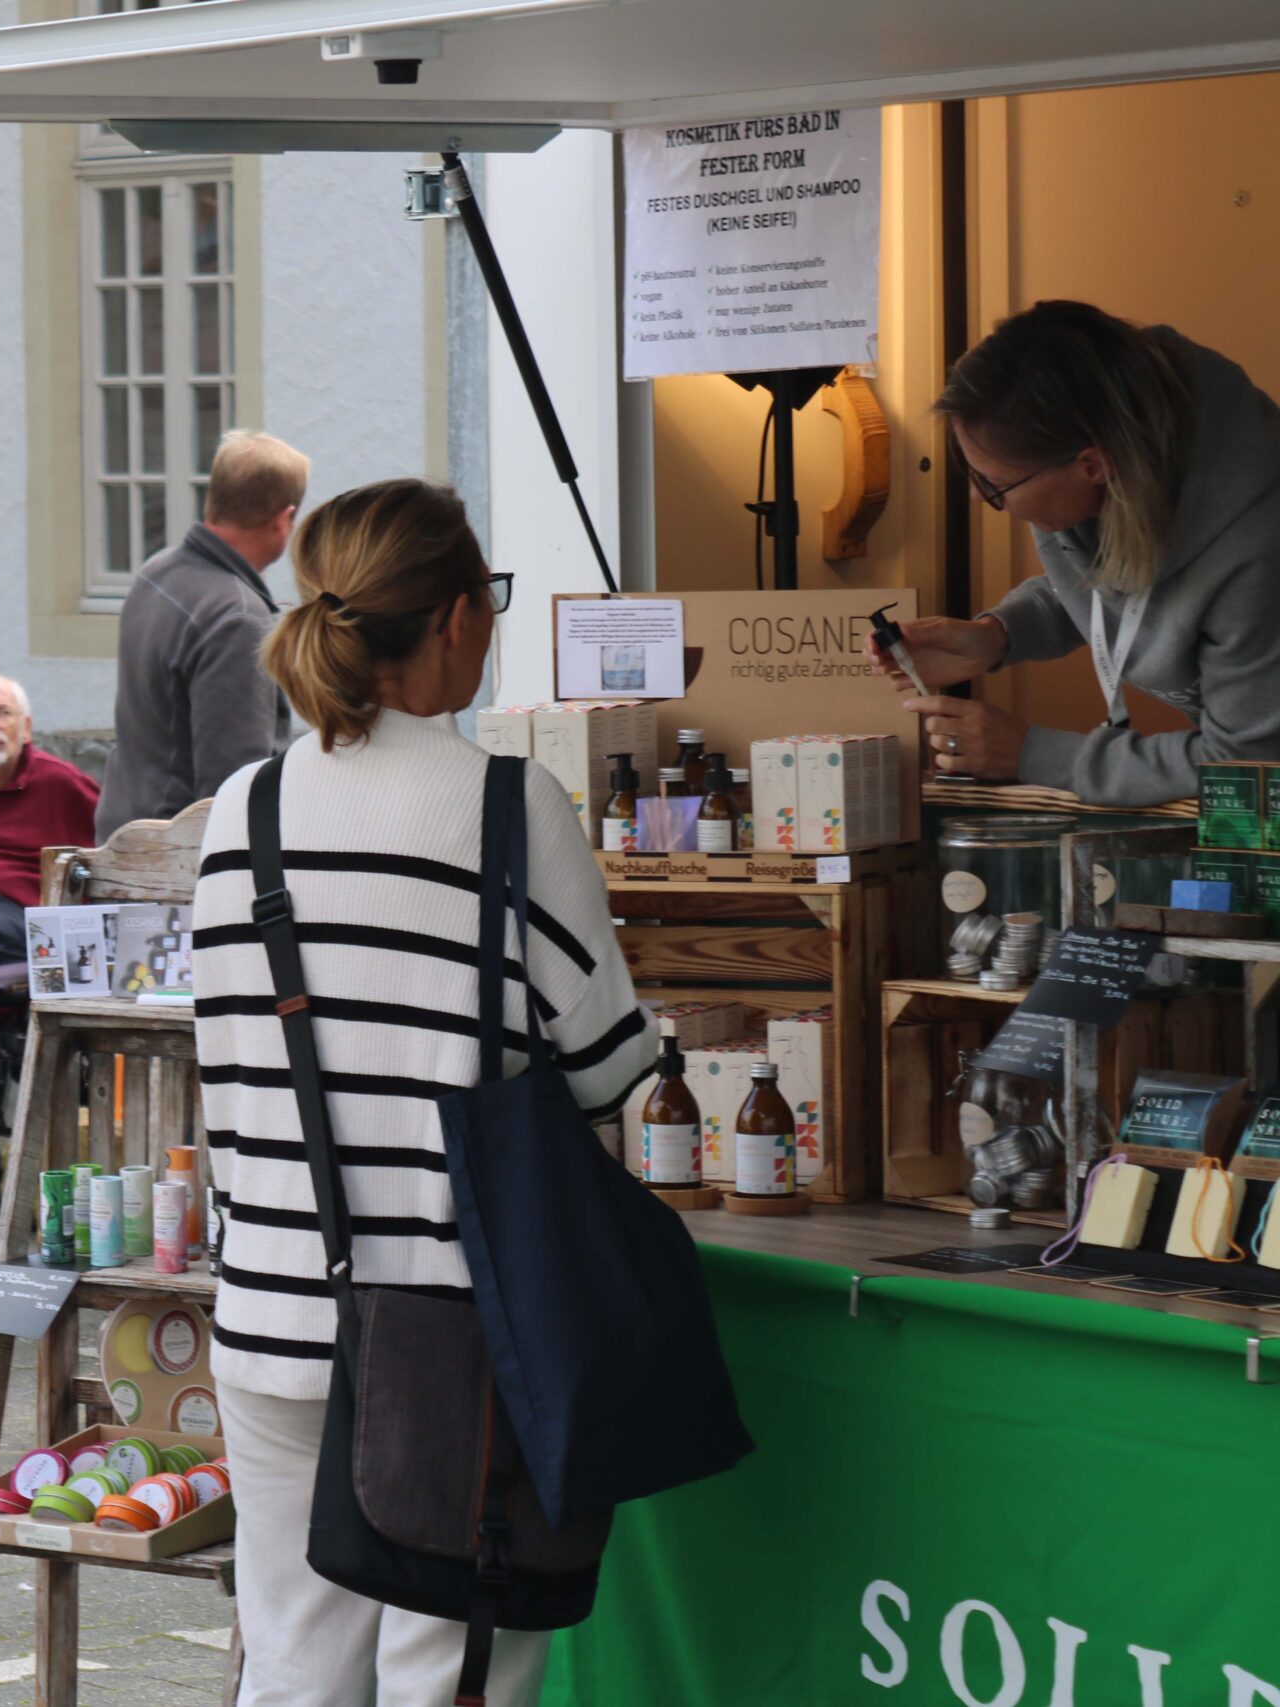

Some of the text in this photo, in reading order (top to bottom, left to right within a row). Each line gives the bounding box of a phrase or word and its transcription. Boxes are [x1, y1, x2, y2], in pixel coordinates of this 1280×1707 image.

[665, 122, 741, 149] KOSMETIK
[787, 113, 821, 136] BAD
[825, 109, 841, 131] IN
[700, 149, 806, 178] FESTER FORM
[647, 178, 861, 214] FESTES DUSCHGEL UND SHAMPOO
[707, 210, 797, 236] (KEINE SEIFE!)
[715, 264, 738, 276] keine
[640, 291, 663, 303] vegan
[640, 309, 684, 322] kein Plastik
[715, 307, 730, 317] nur
[733, 304, 761, 317] wenige
[640, 331, 660, 342] keine
[729, 616, 868, 655] COSANE
[731, 659, 872, 683] richtig gute Zahncre
[605, 860, 708, 875] Nachkaufflasche
[745, 861, 817, 879] Reisegröße
[1136, 1096, 1183, 1111] SOLID
[1133, 1111, 1191, 1128] NATURE
